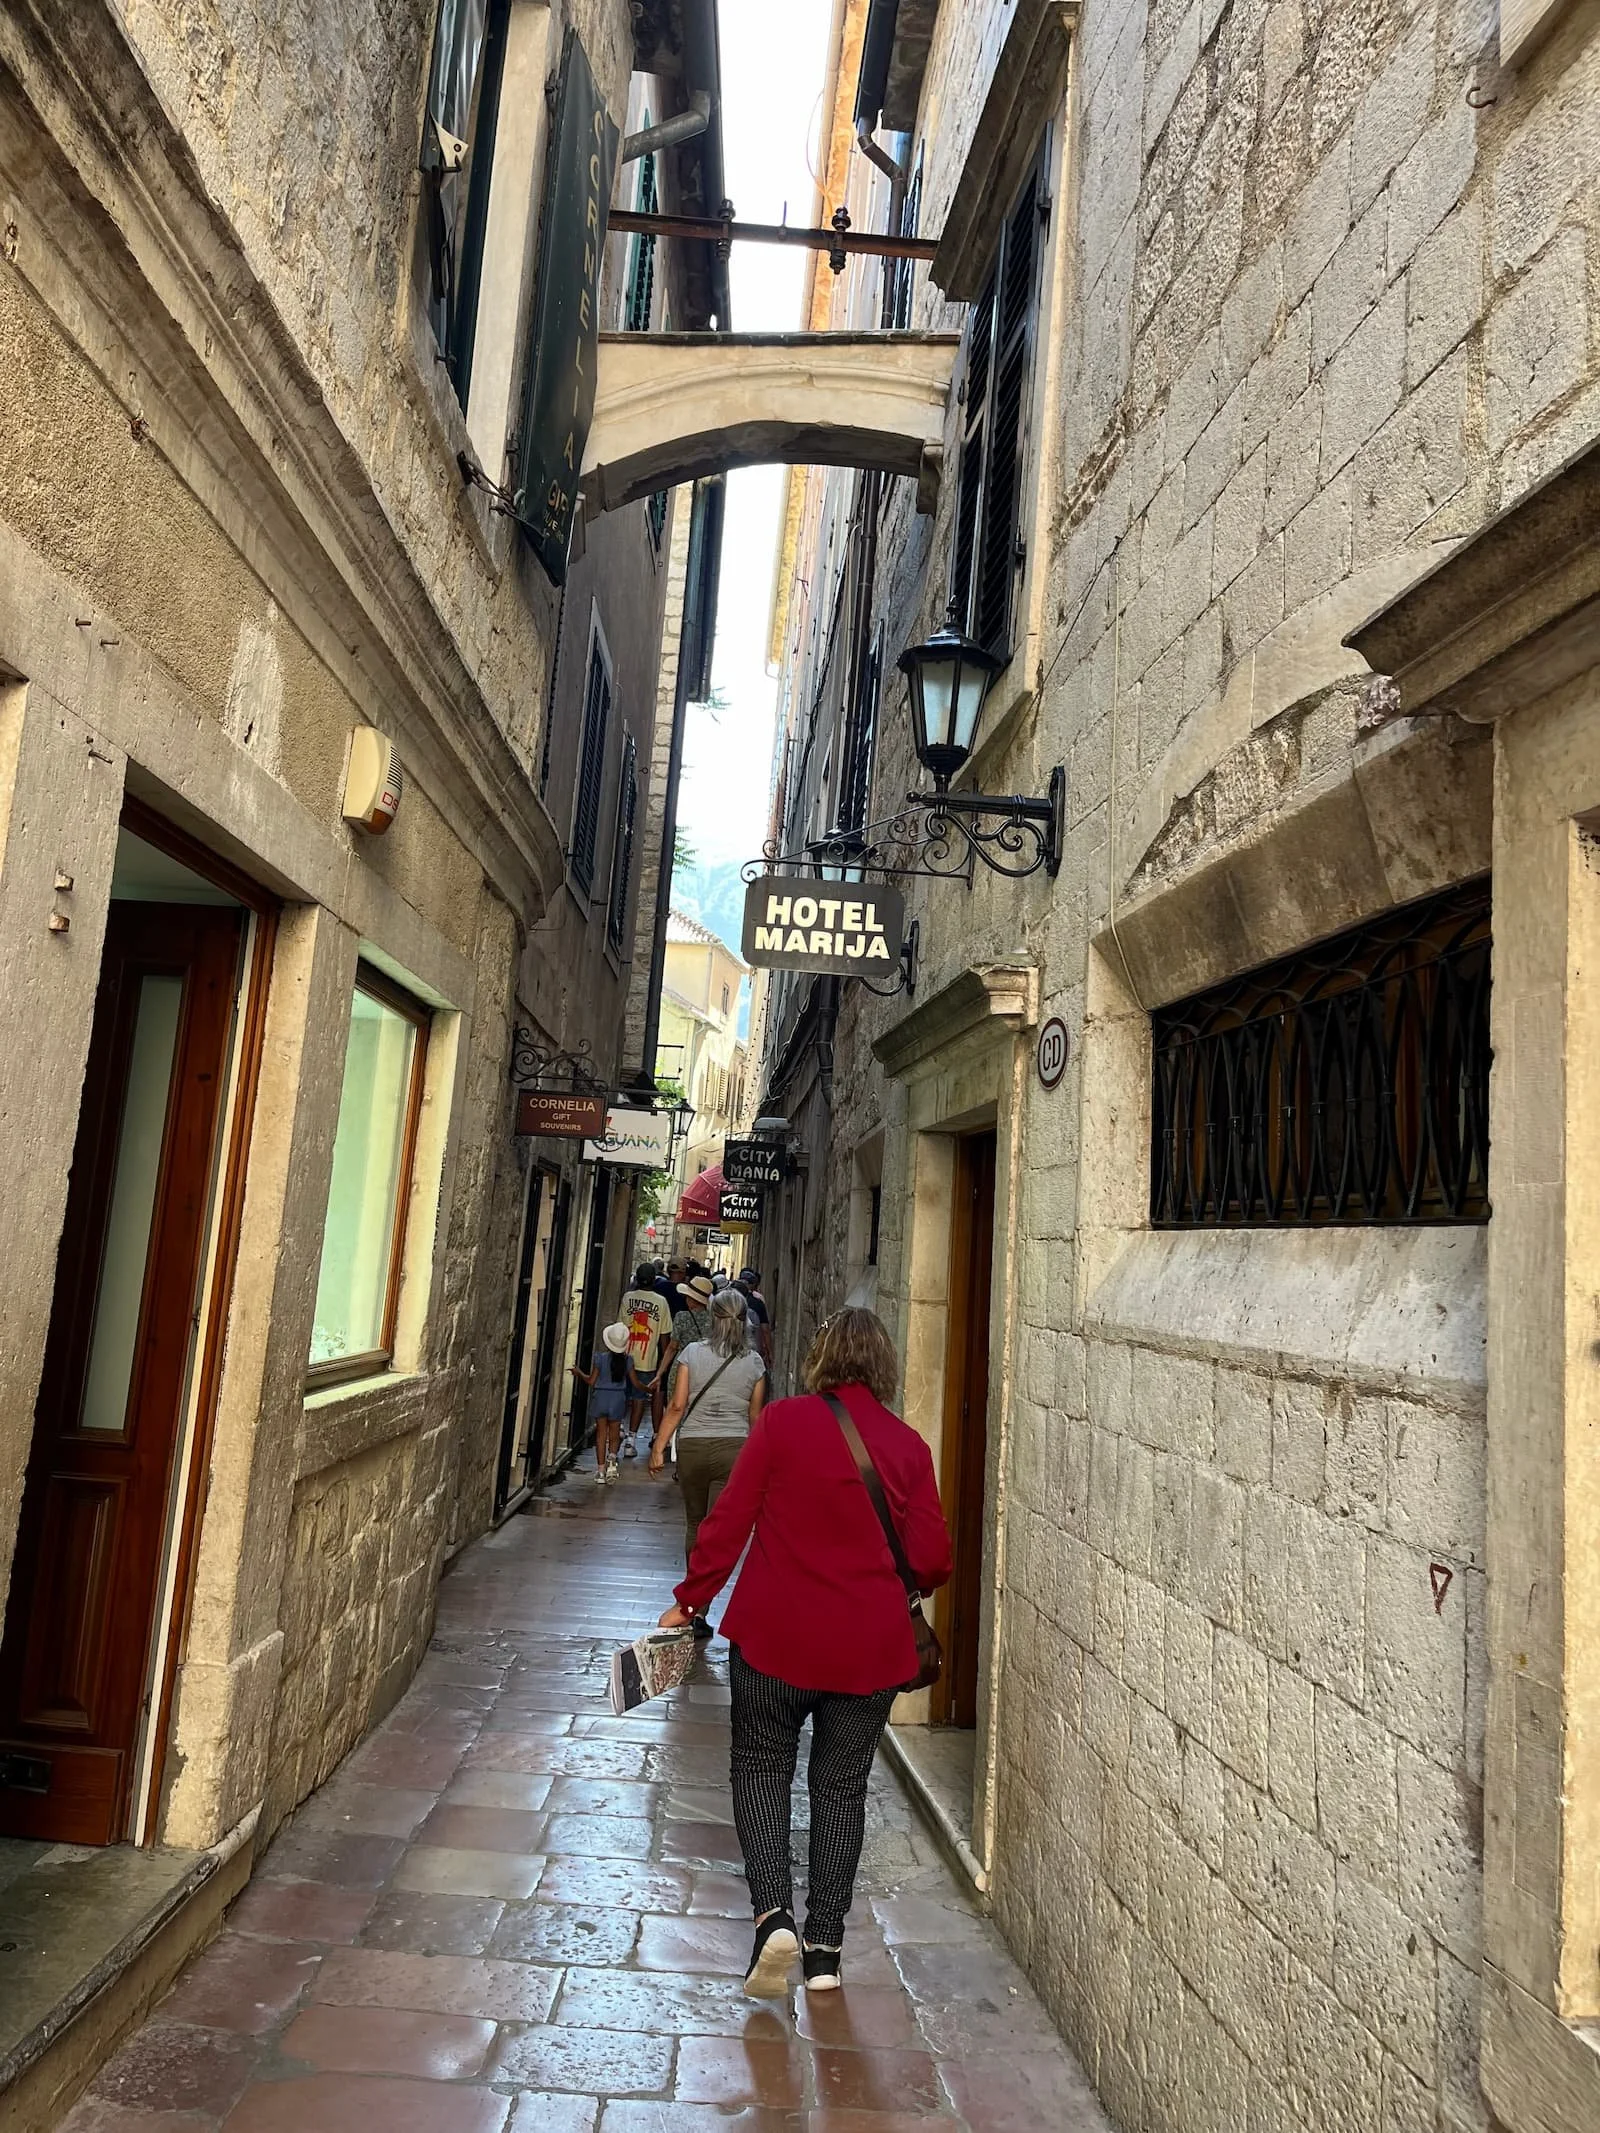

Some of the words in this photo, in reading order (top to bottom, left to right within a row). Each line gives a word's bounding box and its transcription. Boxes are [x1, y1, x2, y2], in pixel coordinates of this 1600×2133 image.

[766, 893, 885, 933] HOTEL
[754, 926, 890, 960] MARIJA
[1043, 1034, 1062, 1071] CD
[529, 1098, 596, 1112] CORNELIA
[552, 1112, 572, 1121] GIFT
[540, 1121, 582, 1131] SOUVENIRS
[739, 1149, 776, 1164] CITY
[730, 1164, 780, 1181] MANIA
[731, 1196, 758, 1208] CITY
[723, 1207, 759, 1220] MANIA
